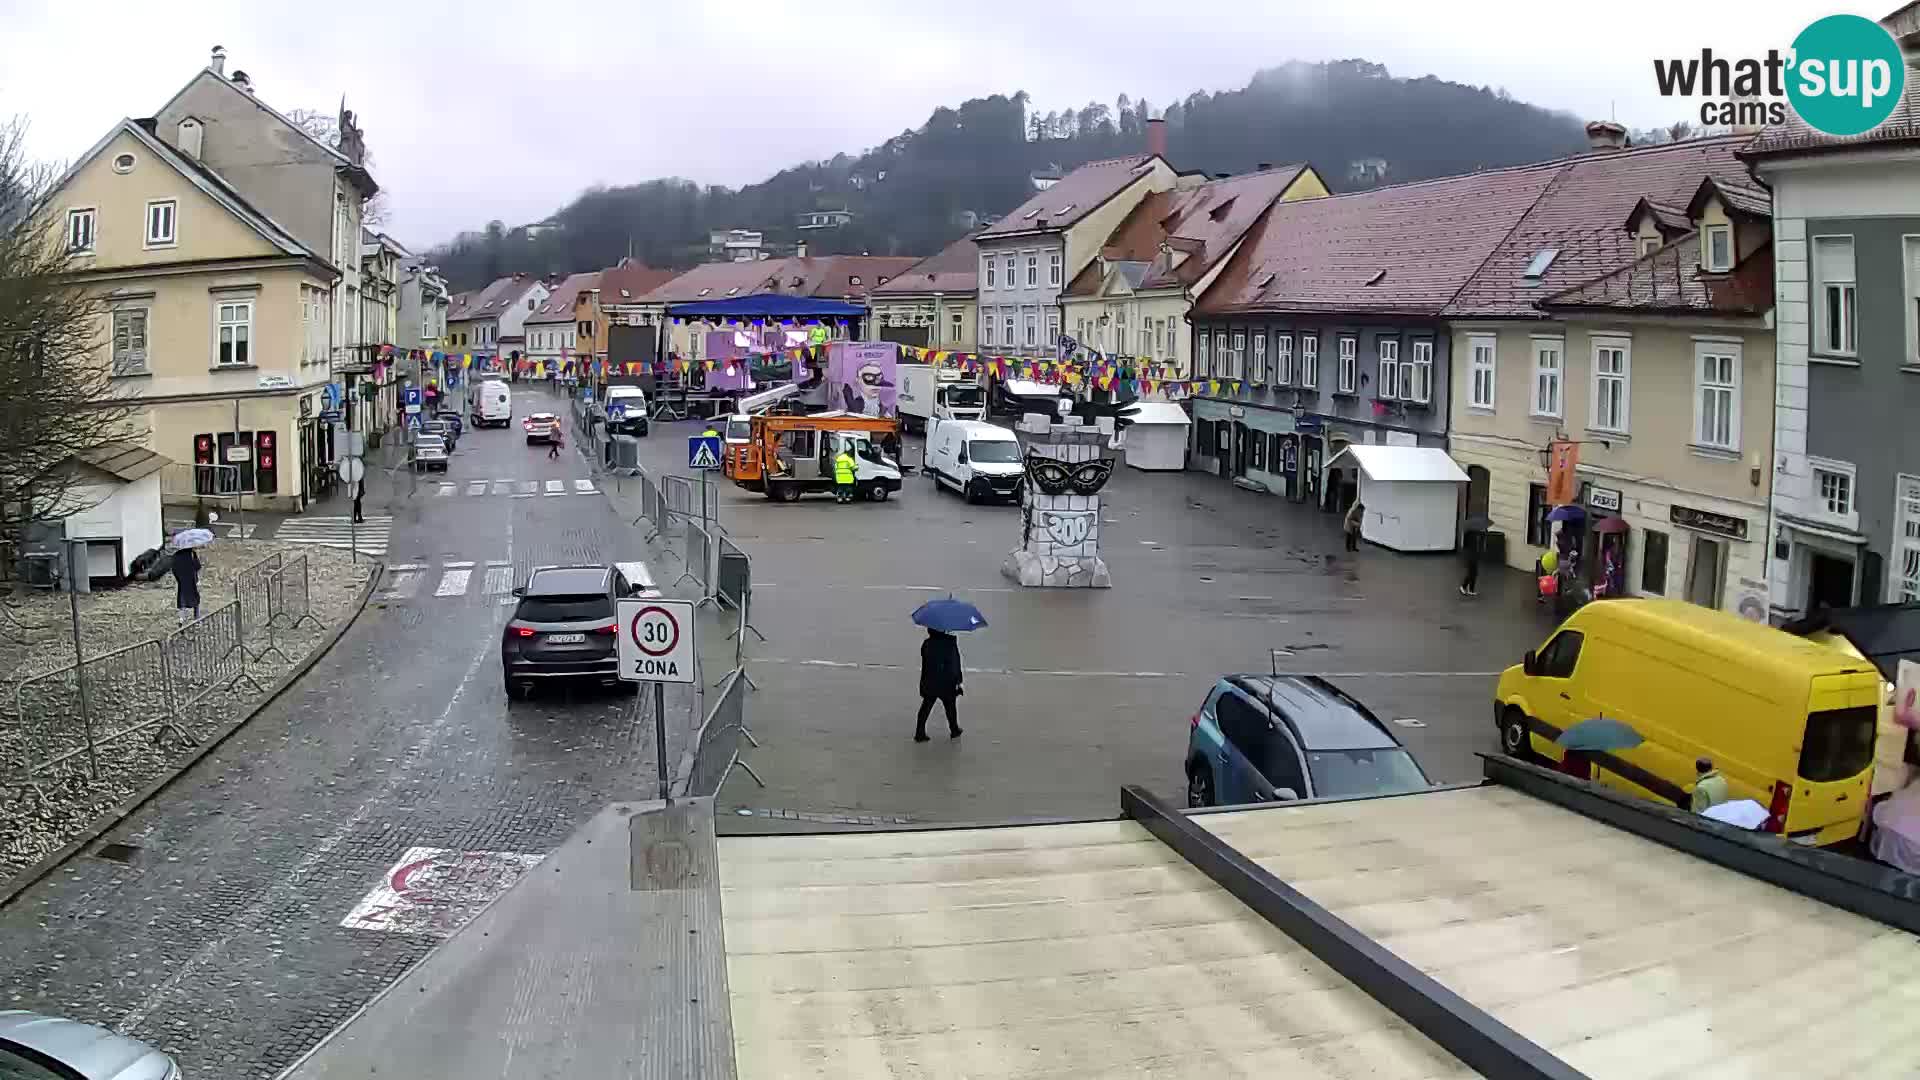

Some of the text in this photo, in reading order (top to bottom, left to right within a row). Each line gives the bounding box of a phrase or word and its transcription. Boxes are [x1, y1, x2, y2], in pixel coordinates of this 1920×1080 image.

[409, 392, 417, 402] P
[1049, 516, 1087, 545] 200
[644, 622, 668, 643] 30
[635, 660, 678, 676] ZONA
